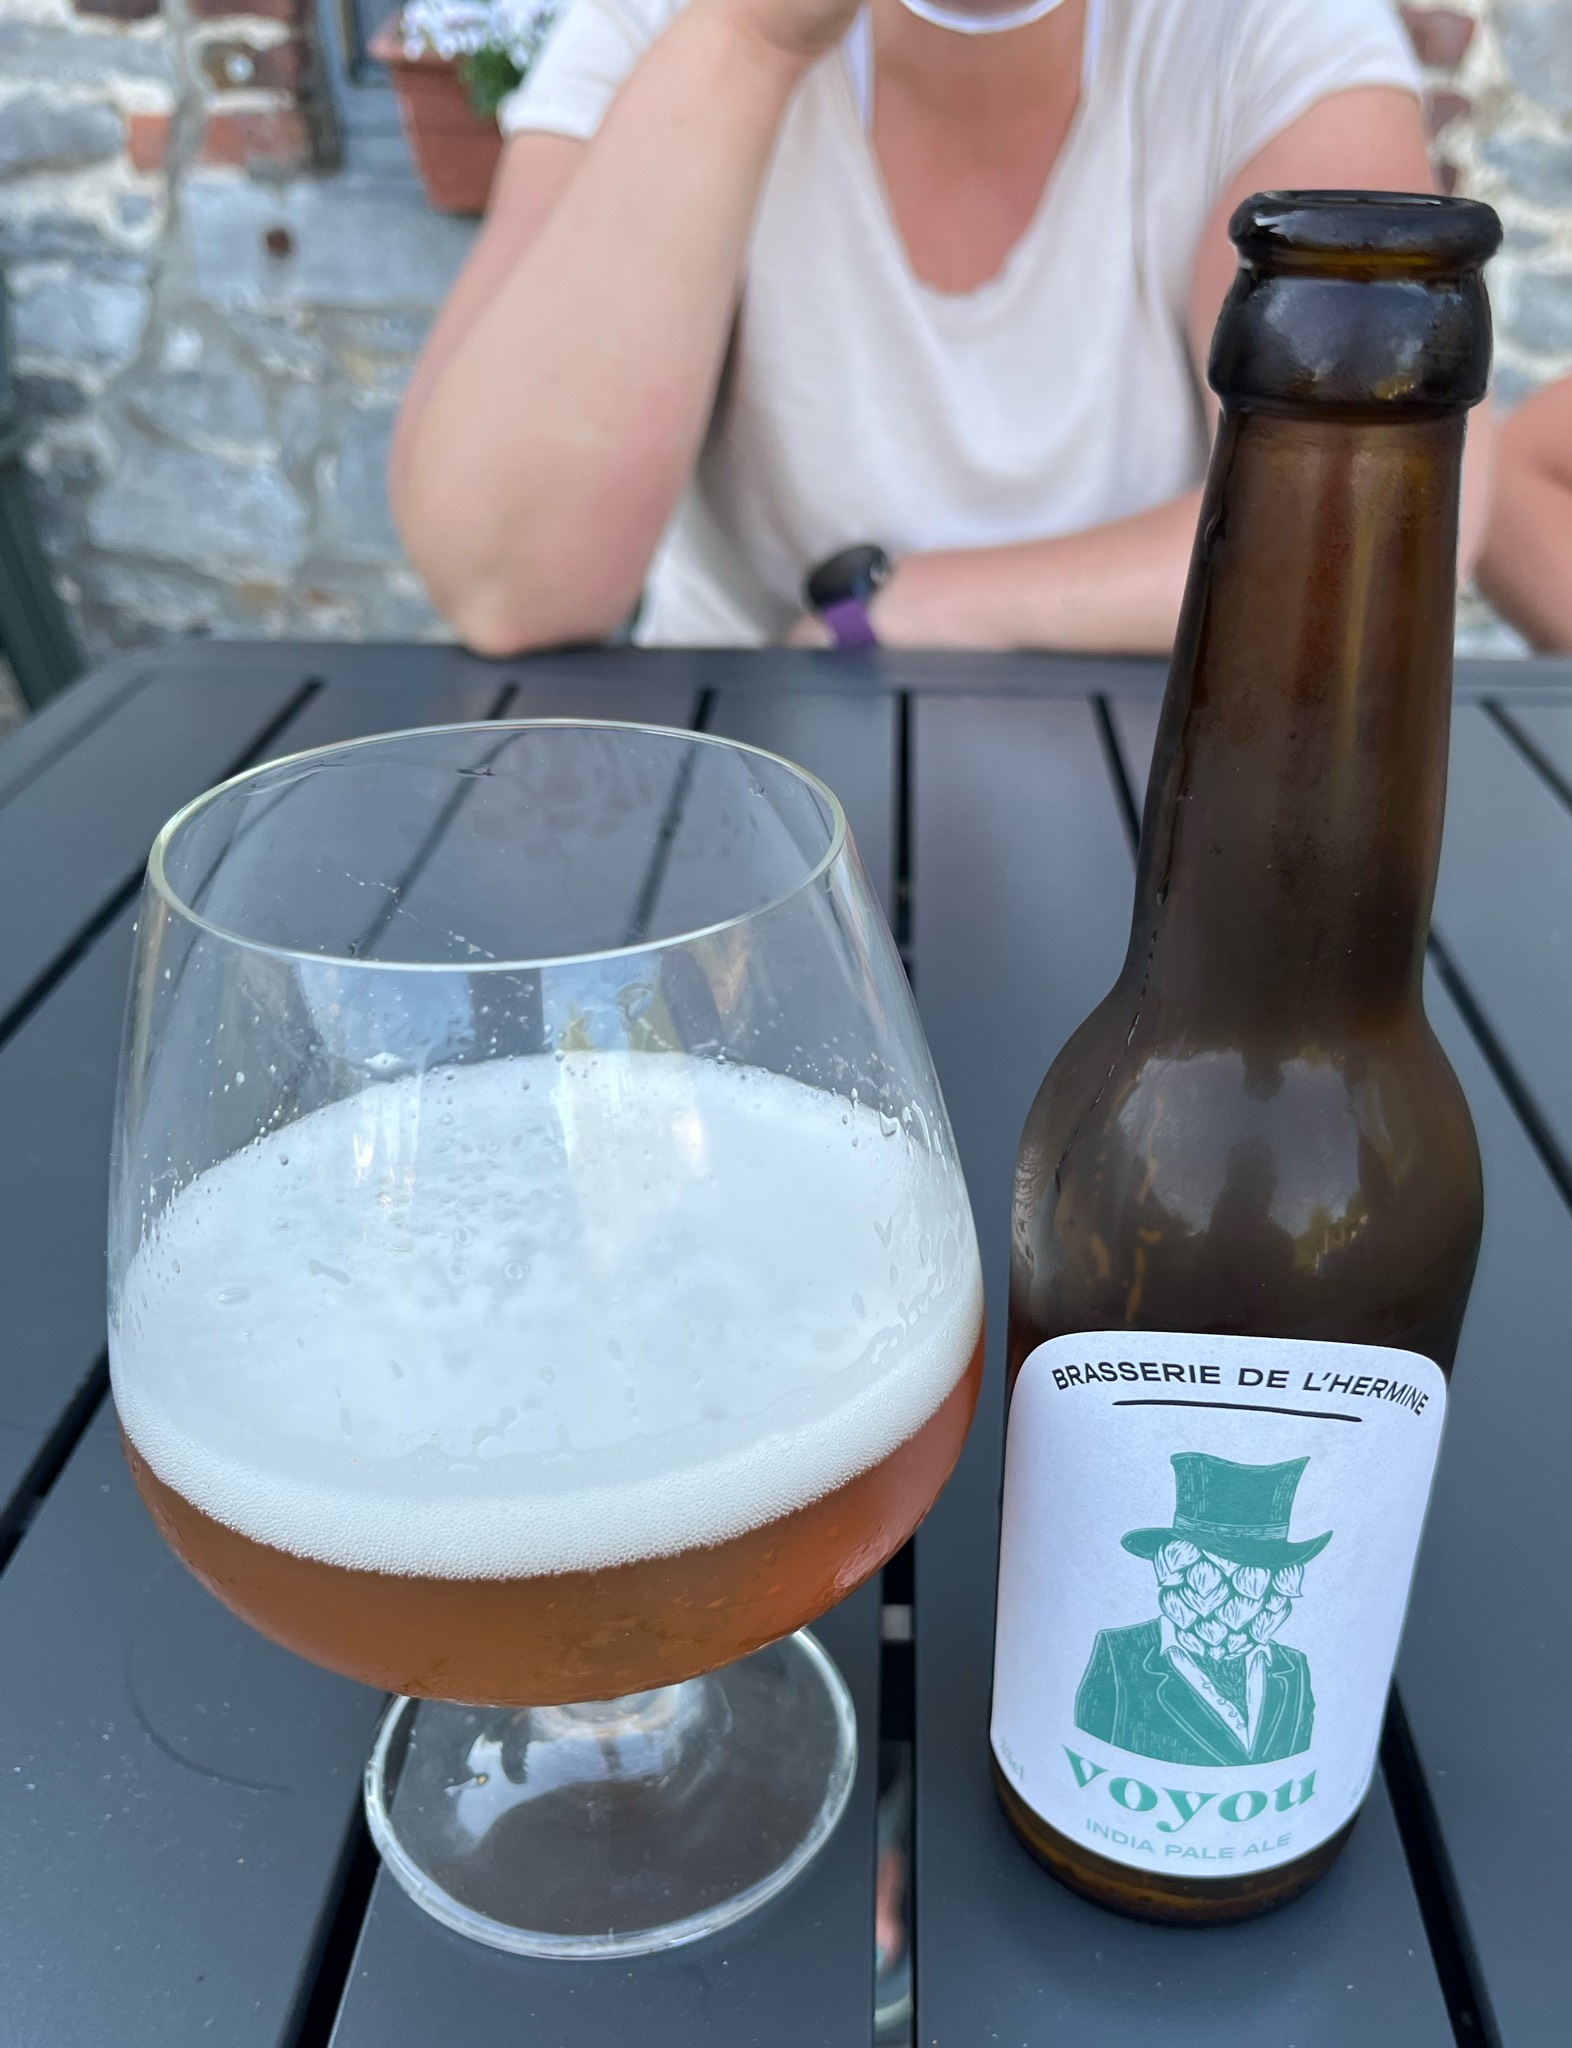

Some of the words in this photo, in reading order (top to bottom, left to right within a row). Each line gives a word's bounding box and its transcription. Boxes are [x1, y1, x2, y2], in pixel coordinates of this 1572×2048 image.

[1052, 1361, 1221, 1390] BRASSERIE
[1238, 1367, 1290, 1388] DE
[1061, 1743, 1318, 1833] voyou
[1086, 1818, 1154, 1853] INDIA
[1164, 1844, 1235, 1860] PALE
[1243, 1832, 1292, 1857] ALE
